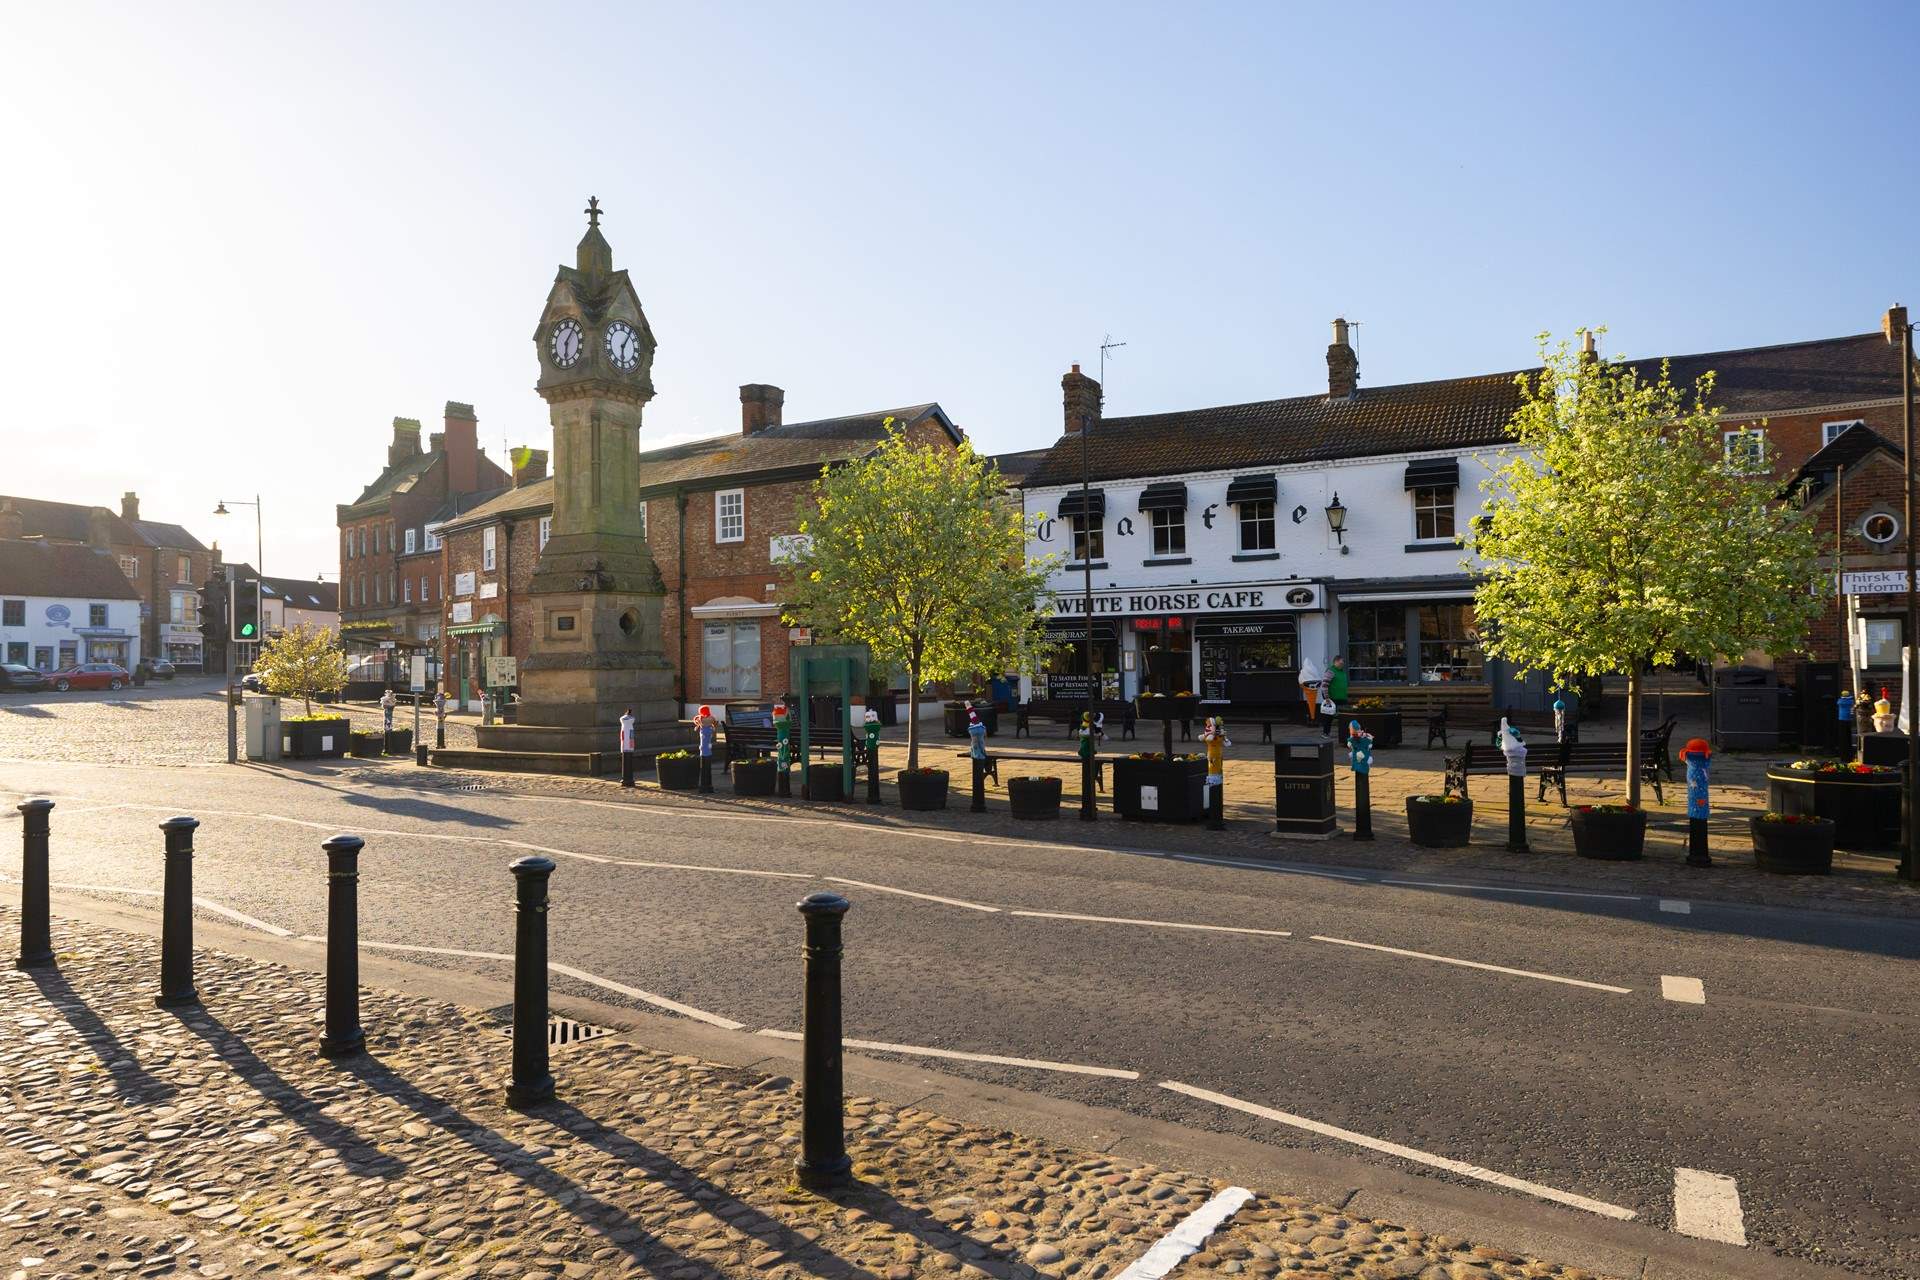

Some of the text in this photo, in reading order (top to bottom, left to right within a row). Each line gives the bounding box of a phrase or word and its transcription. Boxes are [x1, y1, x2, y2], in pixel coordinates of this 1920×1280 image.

[1842, 573, 1890, 584] Thirsk
[1056, 591, 1263, 613] WHITE HORSE CAFE
[1222, 626, 1264, 634] TAKEAWAY
